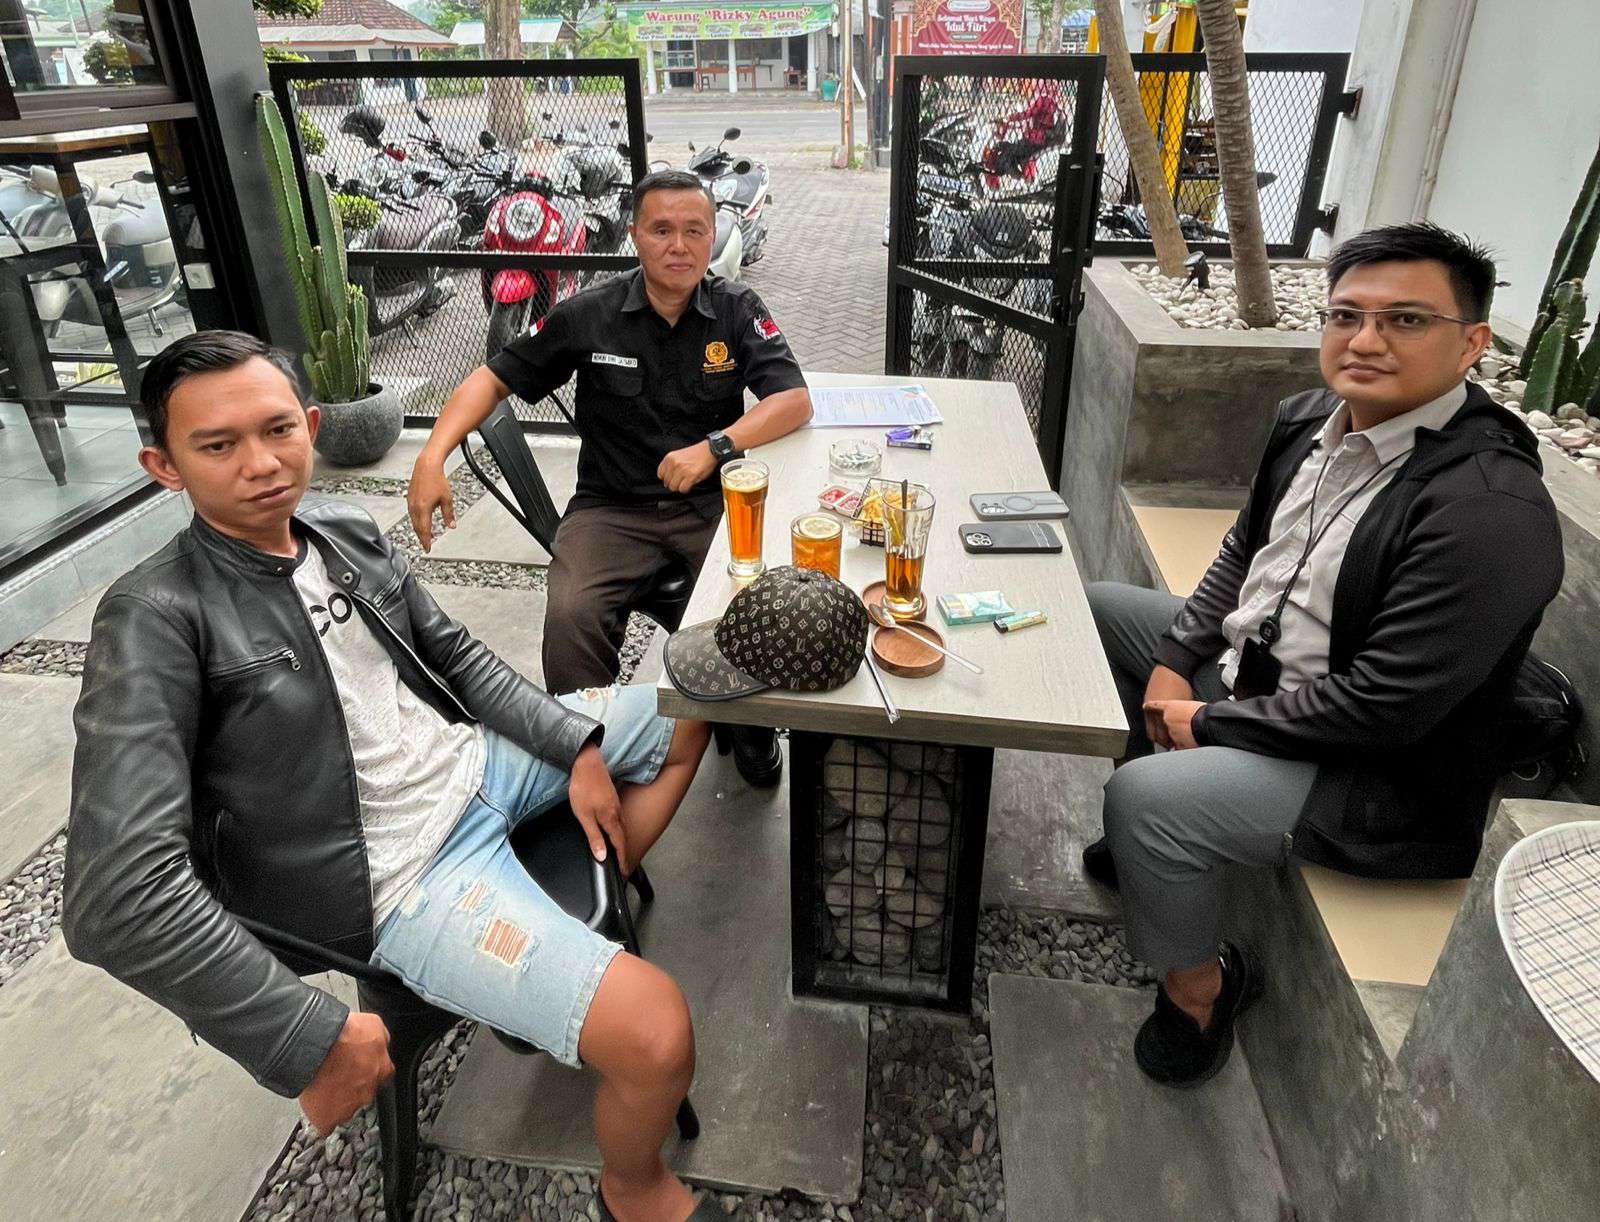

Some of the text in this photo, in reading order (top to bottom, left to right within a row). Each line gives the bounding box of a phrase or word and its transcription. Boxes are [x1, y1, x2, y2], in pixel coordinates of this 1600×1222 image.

[645, 12, 702, 24] Warung
[945, 22, 987, 32] Idul Fitri
